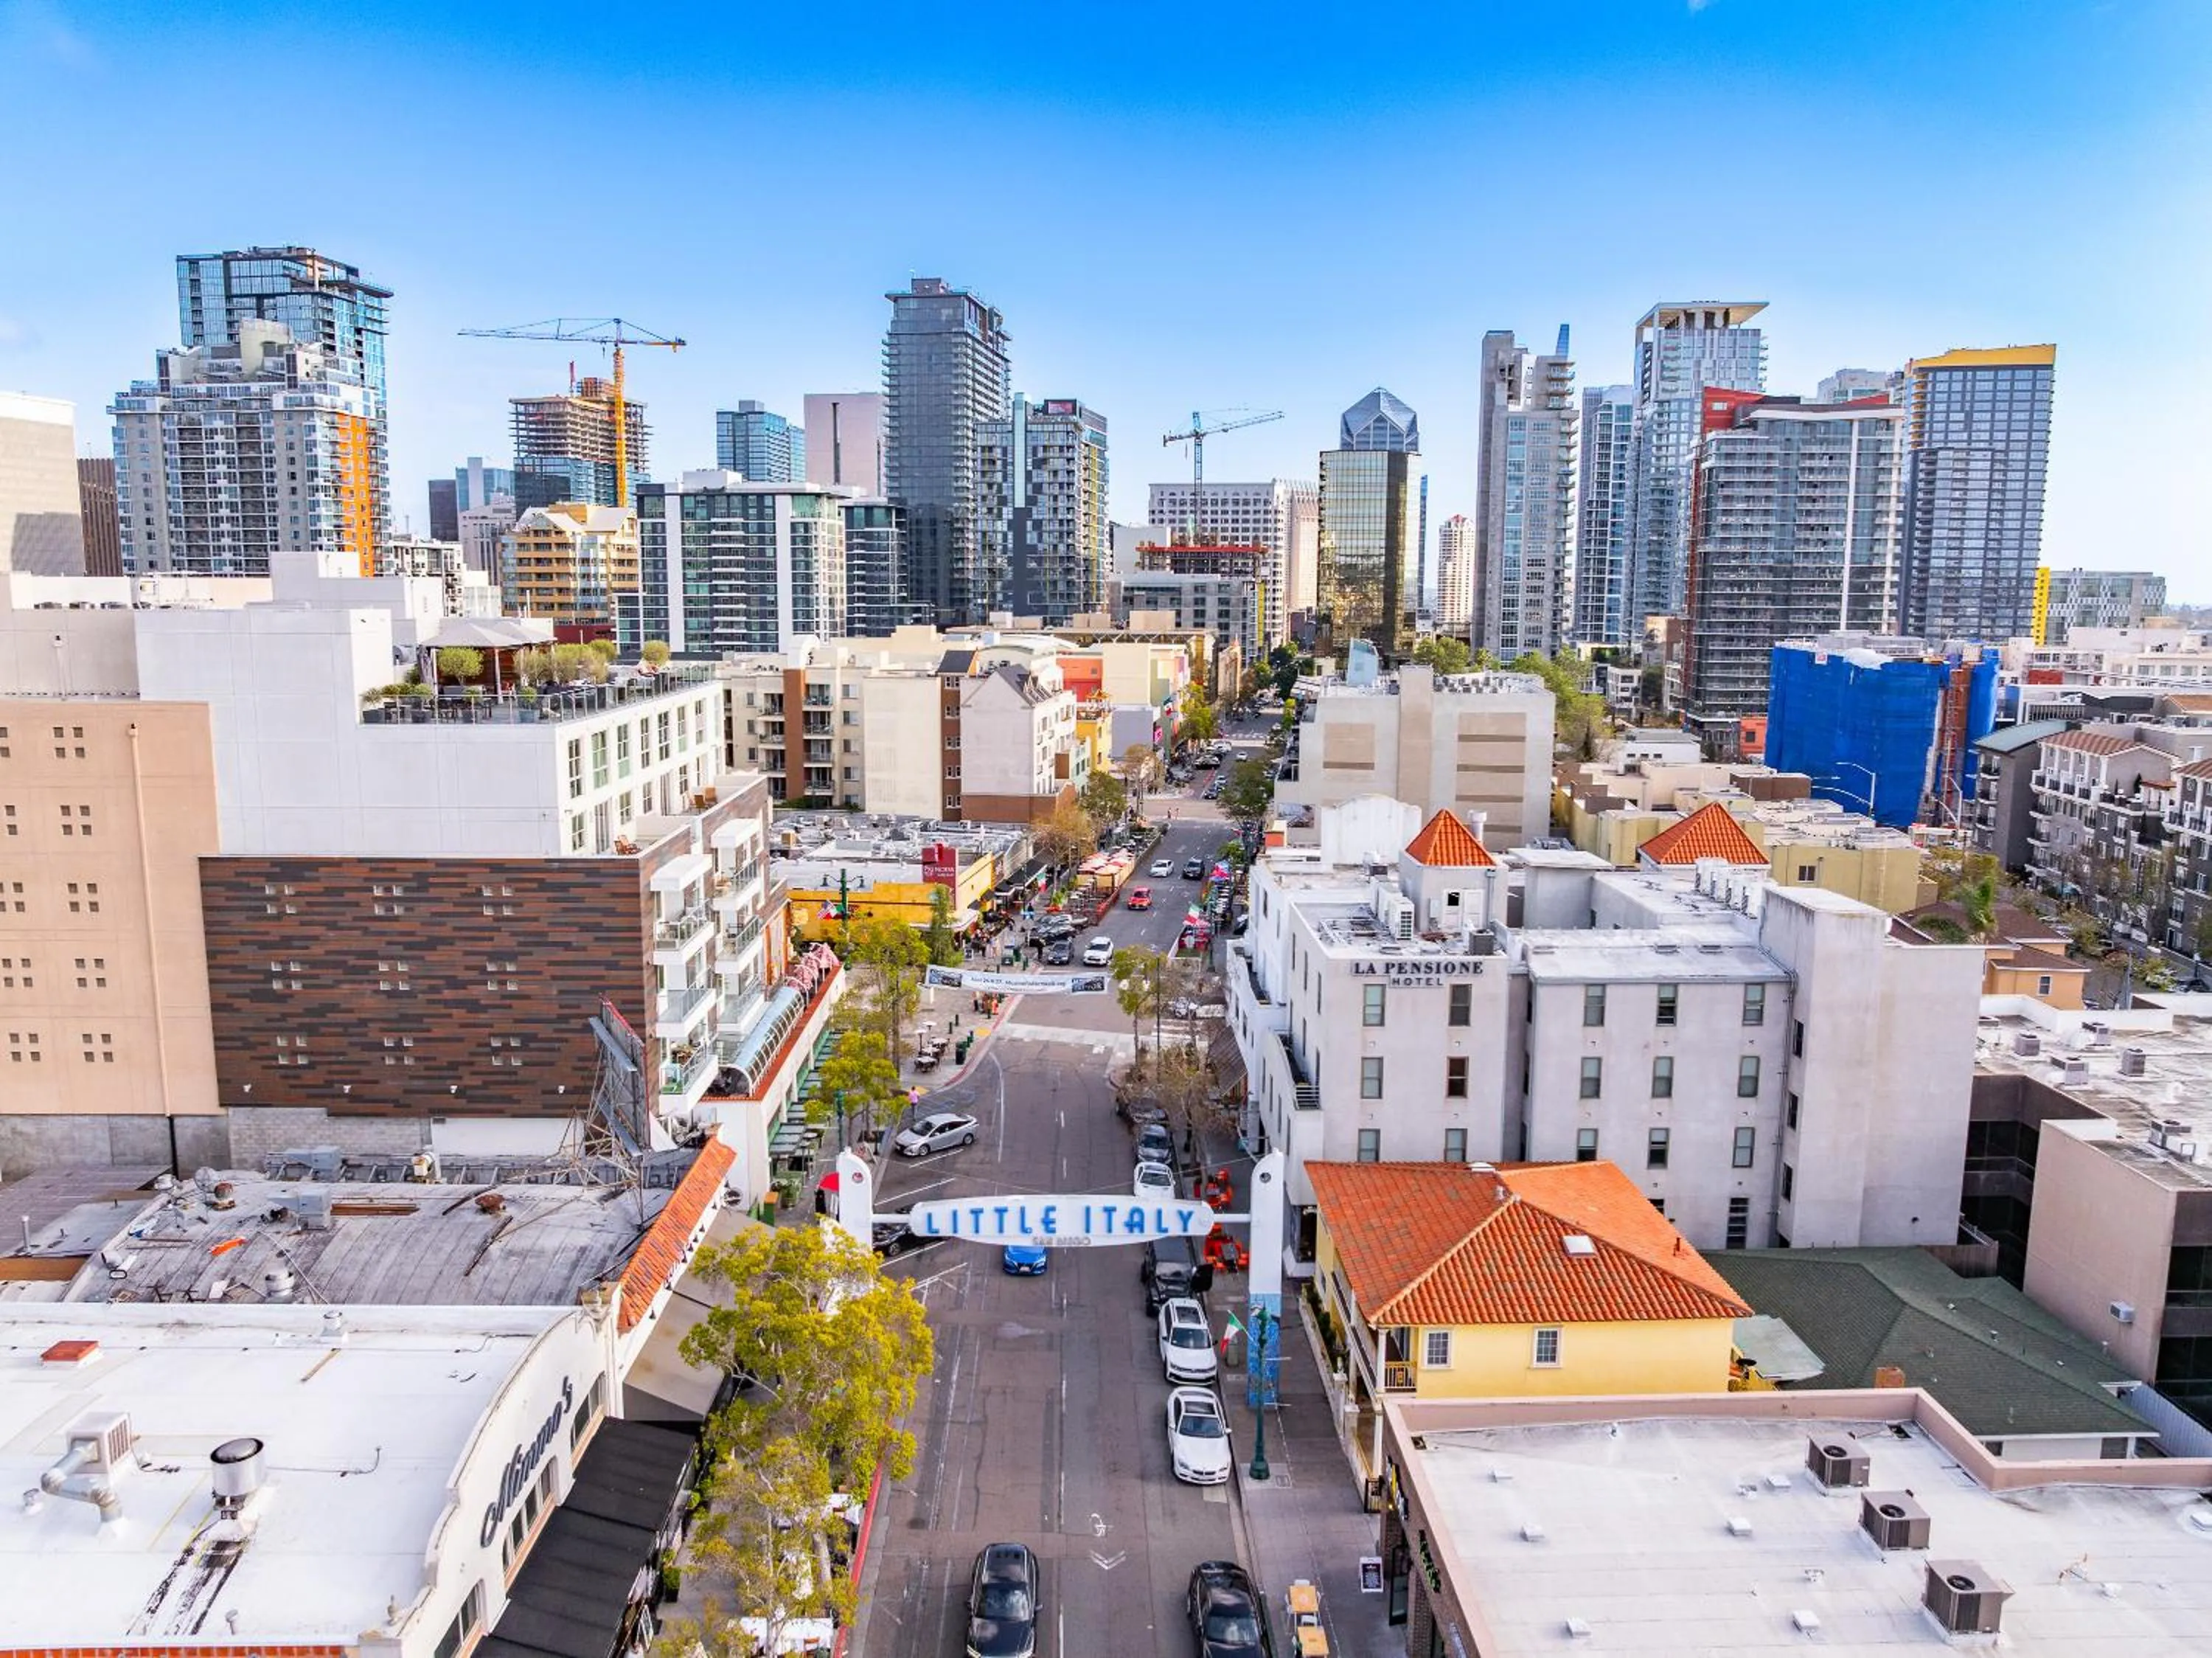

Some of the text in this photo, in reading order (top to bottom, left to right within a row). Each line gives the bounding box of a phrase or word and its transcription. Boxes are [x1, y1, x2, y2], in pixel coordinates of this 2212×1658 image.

[1354, 961, 1484, 974] LA PENSIONE
[1391, 977, 1443, 986] HOTEL
[925, 1204, 1194, 1235] LITTLE ITALY
